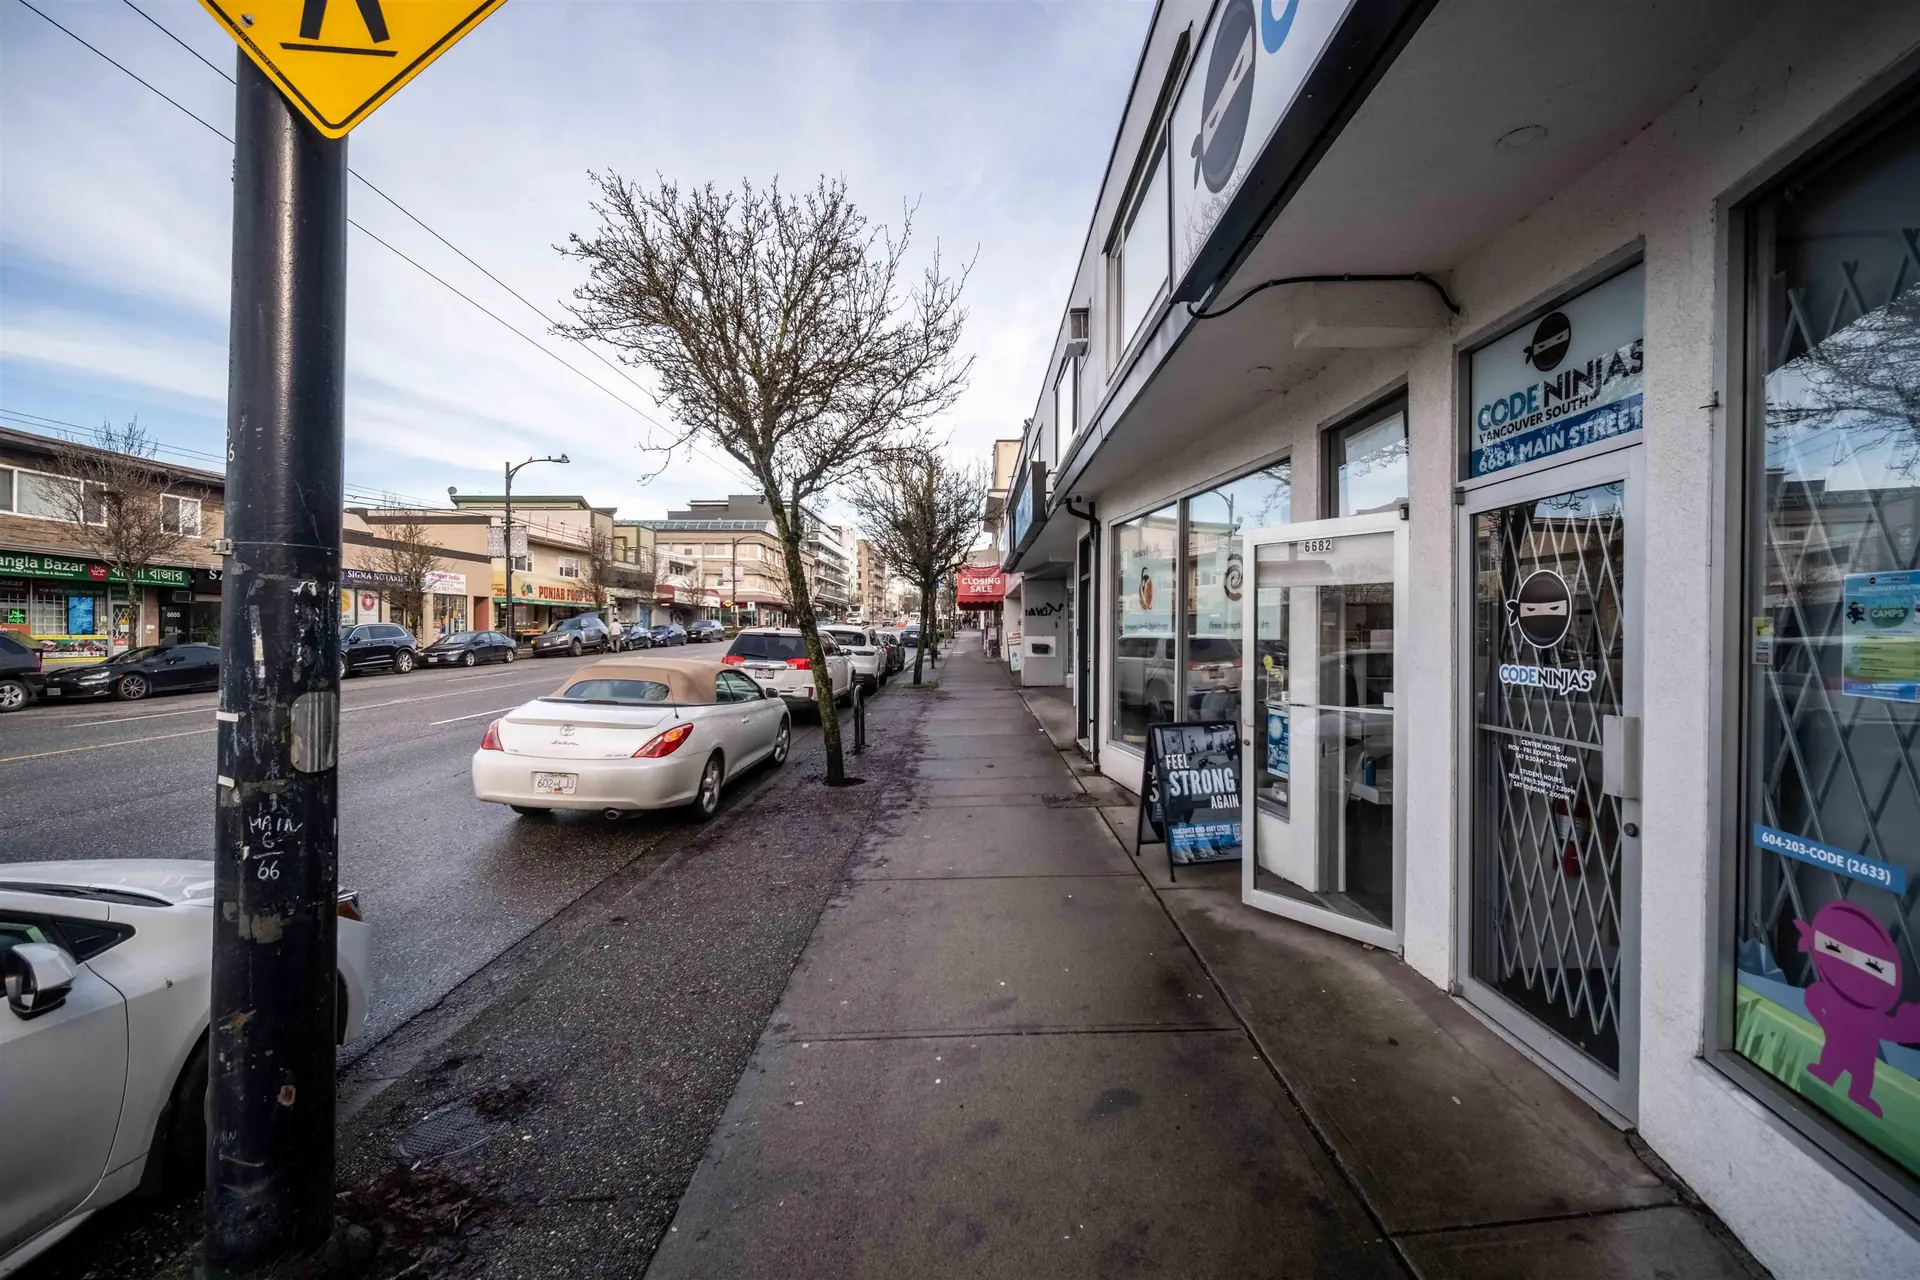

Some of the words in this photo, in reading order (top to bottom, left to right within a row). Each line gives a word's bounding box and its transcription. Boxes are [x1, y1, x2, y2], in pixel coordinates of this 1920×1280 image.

[247, 39, 268, 63] VANCOUVER
[1477, 382, 1540, 432] CODE
[1542, 337, 1644, 408] NINJAS
[1478, 413, 1543, 445] VANCOUVER
[1545, 394, 1590, 421] SOUTH
[1478, 449, 1515, 473] 6684
[1518, 430, 1565, 460] MAIN
[1568, 404, 1644, 446] STREET
[1304, 540, 1332, 553] 6682
[43, 557, 86, 572] Bazar
[347, 569, 372, 580] SIGMA
[961, 577, 1001, 585] CLOSING
[538, 585, 566, 601] PUNJAB
[970, 585, 993, 593] SALE
[1871, 608, 1905, 619] CAMPS
[1500, 665, 1538, 685] CODE
[1537, 668, 1590, 693] NINJAS
[1521, 739, 1541, 748] CENTER
[1541, 743, 1561, 752] HOURS
[1165, 753, 1191, 770] FEEL
[537, 778, 554, 788] 602
[1168, 767, 1237, 797] STRONG
[1509, 772, 1520, 780] MON
[1513, 780, 1523, 788] SAT
[1520, 768, 1542, 778] STUDENT
[1543, 774, 1563, 784] HOURS
[1210, 793, 1240, 810] AGAIN
[1171, 826, 1195, 835] VANCOUVER
[1761, 831, 1845, 868] 604-203-CODE
[1846, 857, 1892, 887] (2633)
[257, 860, 281, 880] 66
